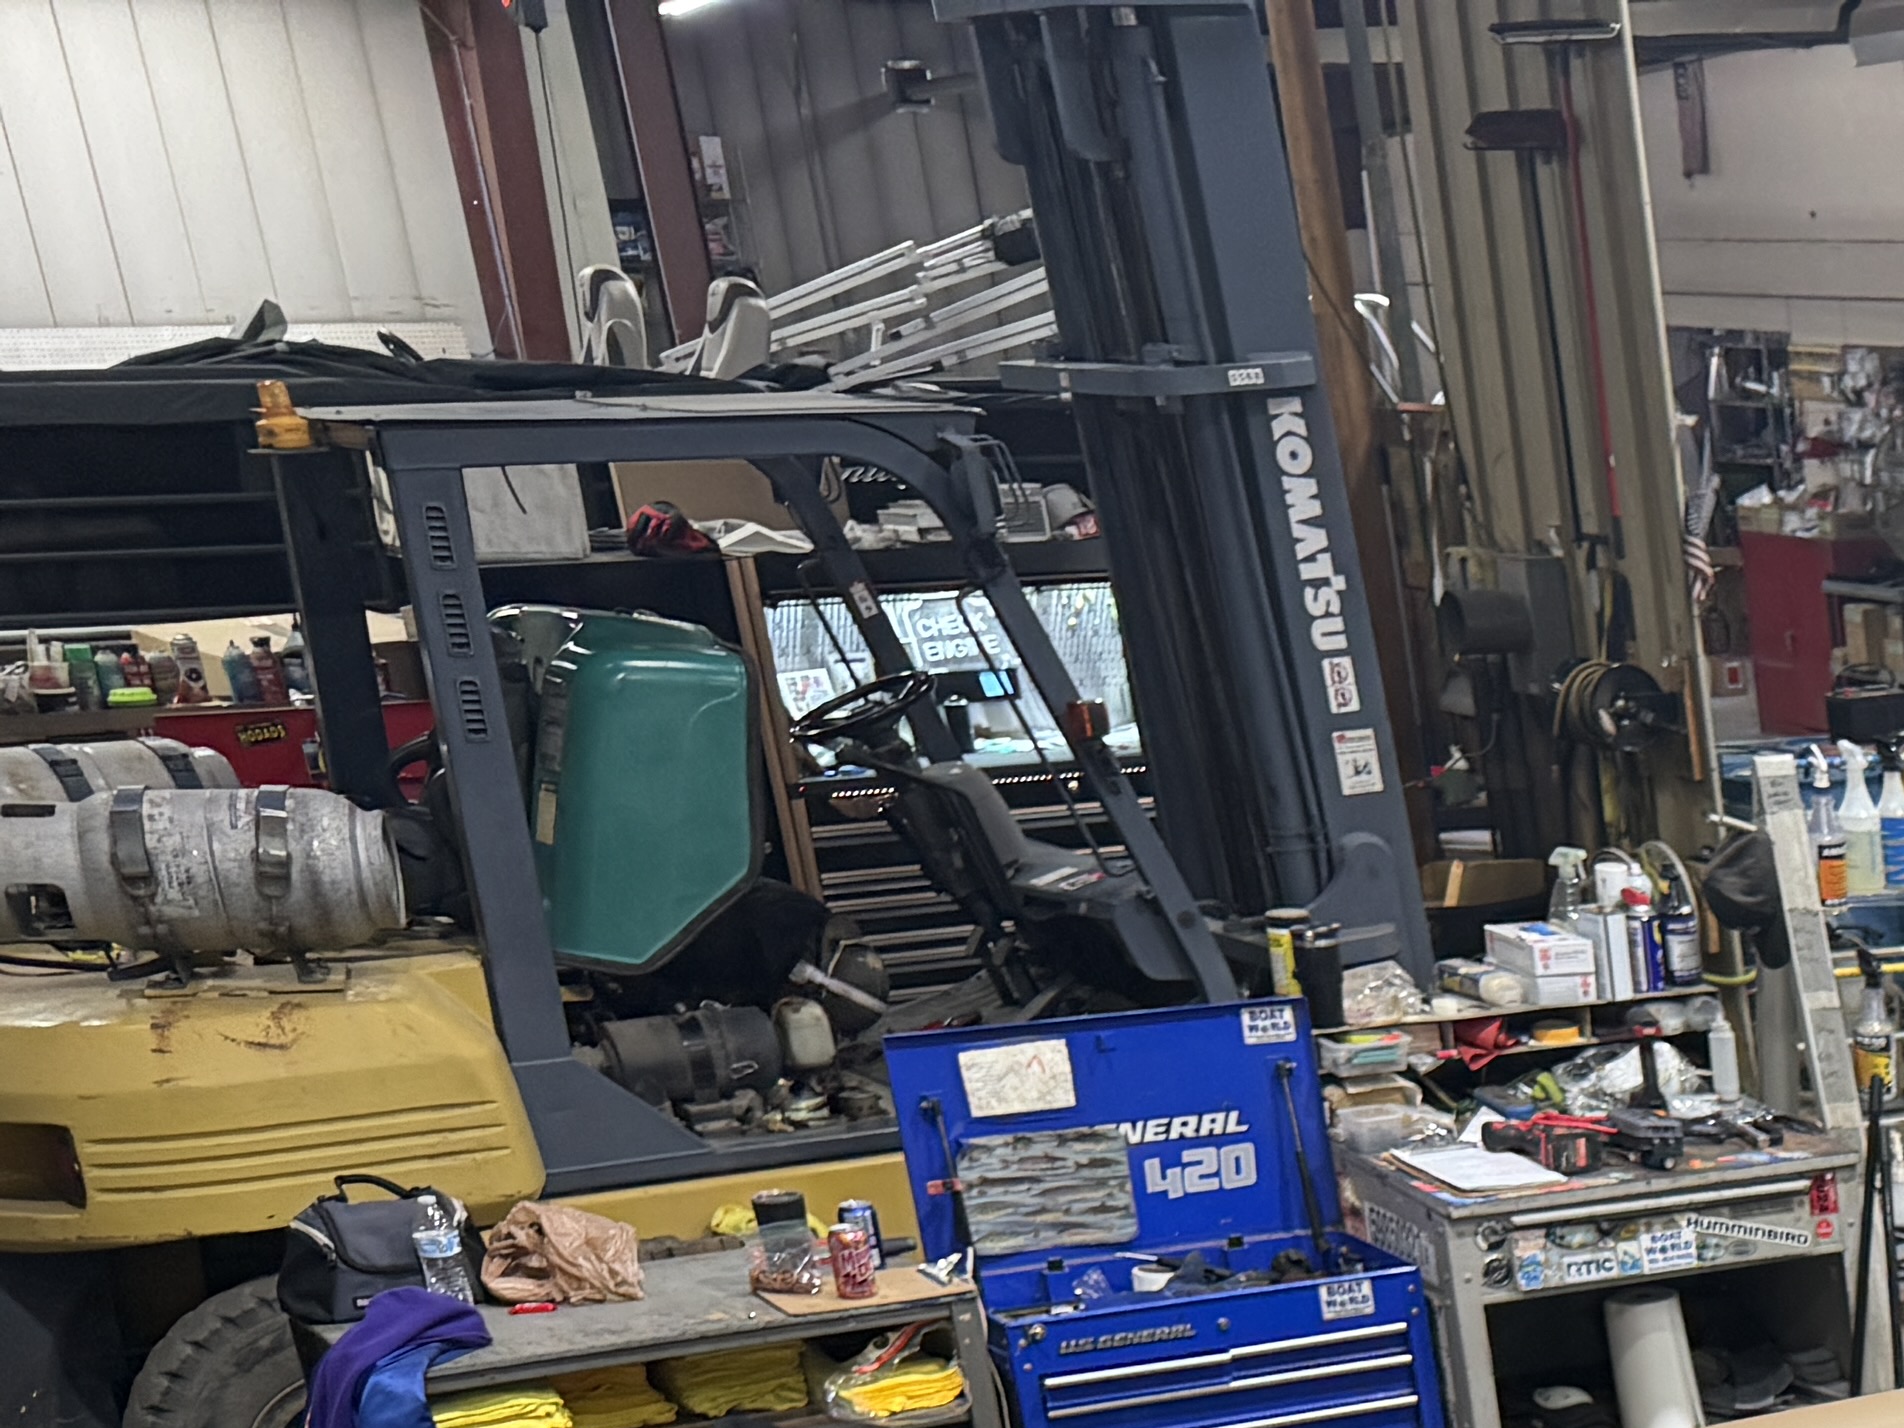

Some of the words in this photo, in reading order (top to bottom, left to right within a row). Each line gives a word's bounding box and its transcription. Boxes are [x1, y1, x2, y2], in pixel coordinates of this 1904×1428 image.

[1266, 396, 1349, 652] KOMATSU
[1249, 1007, 1286, 1023] BOAT
[1143, 1141, 1258, 1200] 420
[1686, 1216, 1810, 1247] HUMMINBIRD
[1566, 1252, 1617, 1279] RTIC
[1326, 1282, 1364, 1297] BOAT
